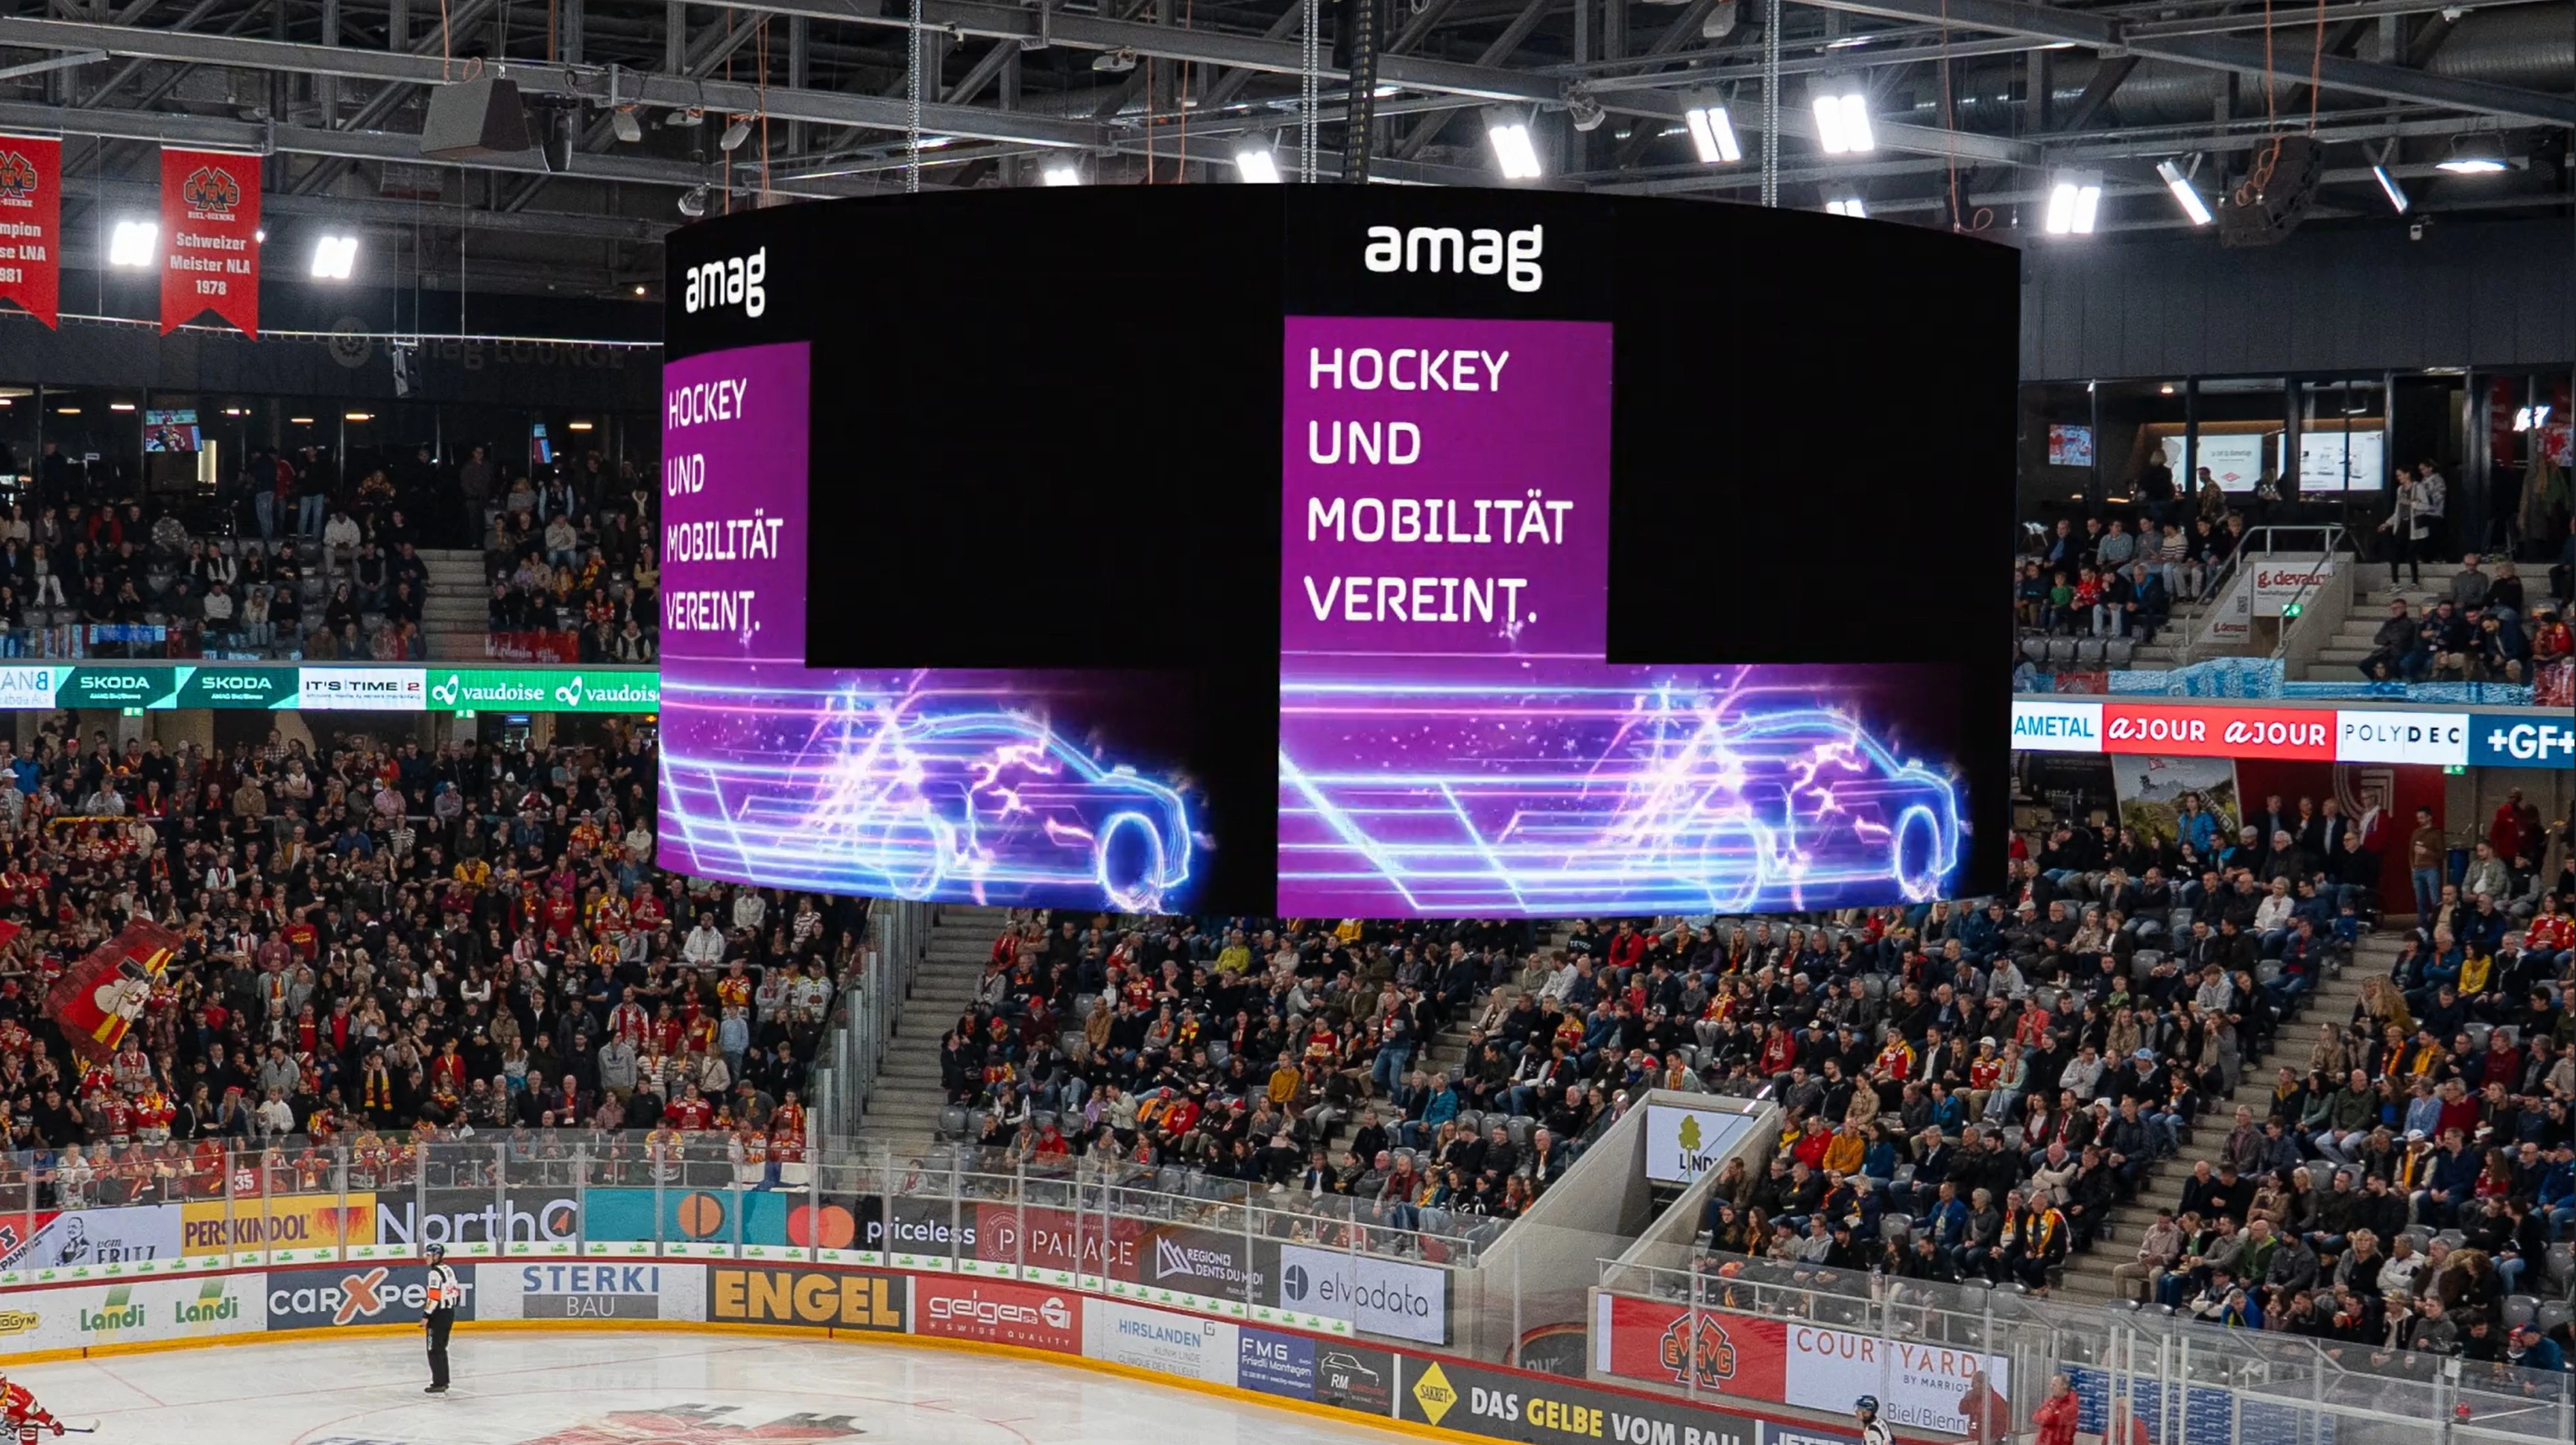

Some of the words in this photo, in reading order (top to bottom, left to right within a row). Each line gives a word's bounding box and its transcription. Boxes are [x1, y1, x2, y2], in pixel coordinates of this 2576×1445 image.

[19, 244, 46, 262] LNA
[176, 233, 247, 251] Schweizer
[170, 255, 223, 273] Meister
[226, 259, 251, 275] NLA
[1365, 224, 1544, 292] amag
[195, 279, 227, 296] 1978
[686, 246, 766, 318] amag
[1309, 347, 1509, 392] HOCKEY
[669, 378, 748, 430] HOCKEY
[1308, 420, 1421, 465] UND
[667, 453, 705, 497] UND
[1307, 488, 1574, 545] MOBILITÄT
[666, 508, 784, 563] MOBILITÄT
[2273, 570, 2329, 586] devau
[666, 590, 761, 631] VEREINT.
[1304, 575, 1538, 624] VEREINT.
[80, 676, 151, 689] SKODA
[201, 677, 273, 690] SKODA
[306, 681, 341, 691] IT'S
[349, 681, 398, 691] TIME
[407, 682, 420, 691] 2
[461, 683, 545, 701] vaudoise
[585, 683, 660, 703] vaudois
[2014, 715, 2095, 738] AMETAL
[1679, 1154, 1718, 1172] LIND
[234, 1174, 254, 1191] 35
[184, 1214, 310, 1248] PERSKINDOL
[376, 1198, 578, 1245] NorthC
[866, 1216, 976, 1245] priceless
[97, 1238, 122, 1248] vom
[97, 1245, 157, 1265] FRITZ
[1032, 1230, 1134, 1267] PALACE
[1187, 1248, 1223, 1265] REGION
[523, 1265, 659, 1292] STERKI
[1195, 1264, 1225, 1280] DENTS
[1226, 1269, 1241, 1283] DU
[566, 1296, 615, 1317] BAU
[716, 1270, 900, 1327] ENGEL
[929, 1289, 1038, 1325] geiger
[1319, 1271, 1429, 1318] elvadata
[80, 1303, 145, 1332] Landi
[174, 1297, 239, 1324] Landi
[946, 1322, 997, 1336] SWISS
[1007, 1330, 1070, 1347] QUALITY
[1119, 1318, 1202, 1348] HIRSLANDEN
[1178, 1350, 1201, 1363] LINDE
[1241, 1337, 1288, 1362] FMG
[1663, 1337, 1733, 1373] EHC
[1152, 1360, 1167, 1373] DES
[1269, 1360, 1312, 1378] Montagen
[1330, 1373, 1350, 1390] RM
[1902, 1374, 1919, 1385] BY
[1920, 1379, 1969, 1394] MARRIOT
[1470, 1386, 1519, 1422] DAS
[1526, 1397, 1604, 1438] GELBE
[1611, 1411, 1678, 1445] VOM
[1887, 1402, 1969, 1432] Biel/Bienn
